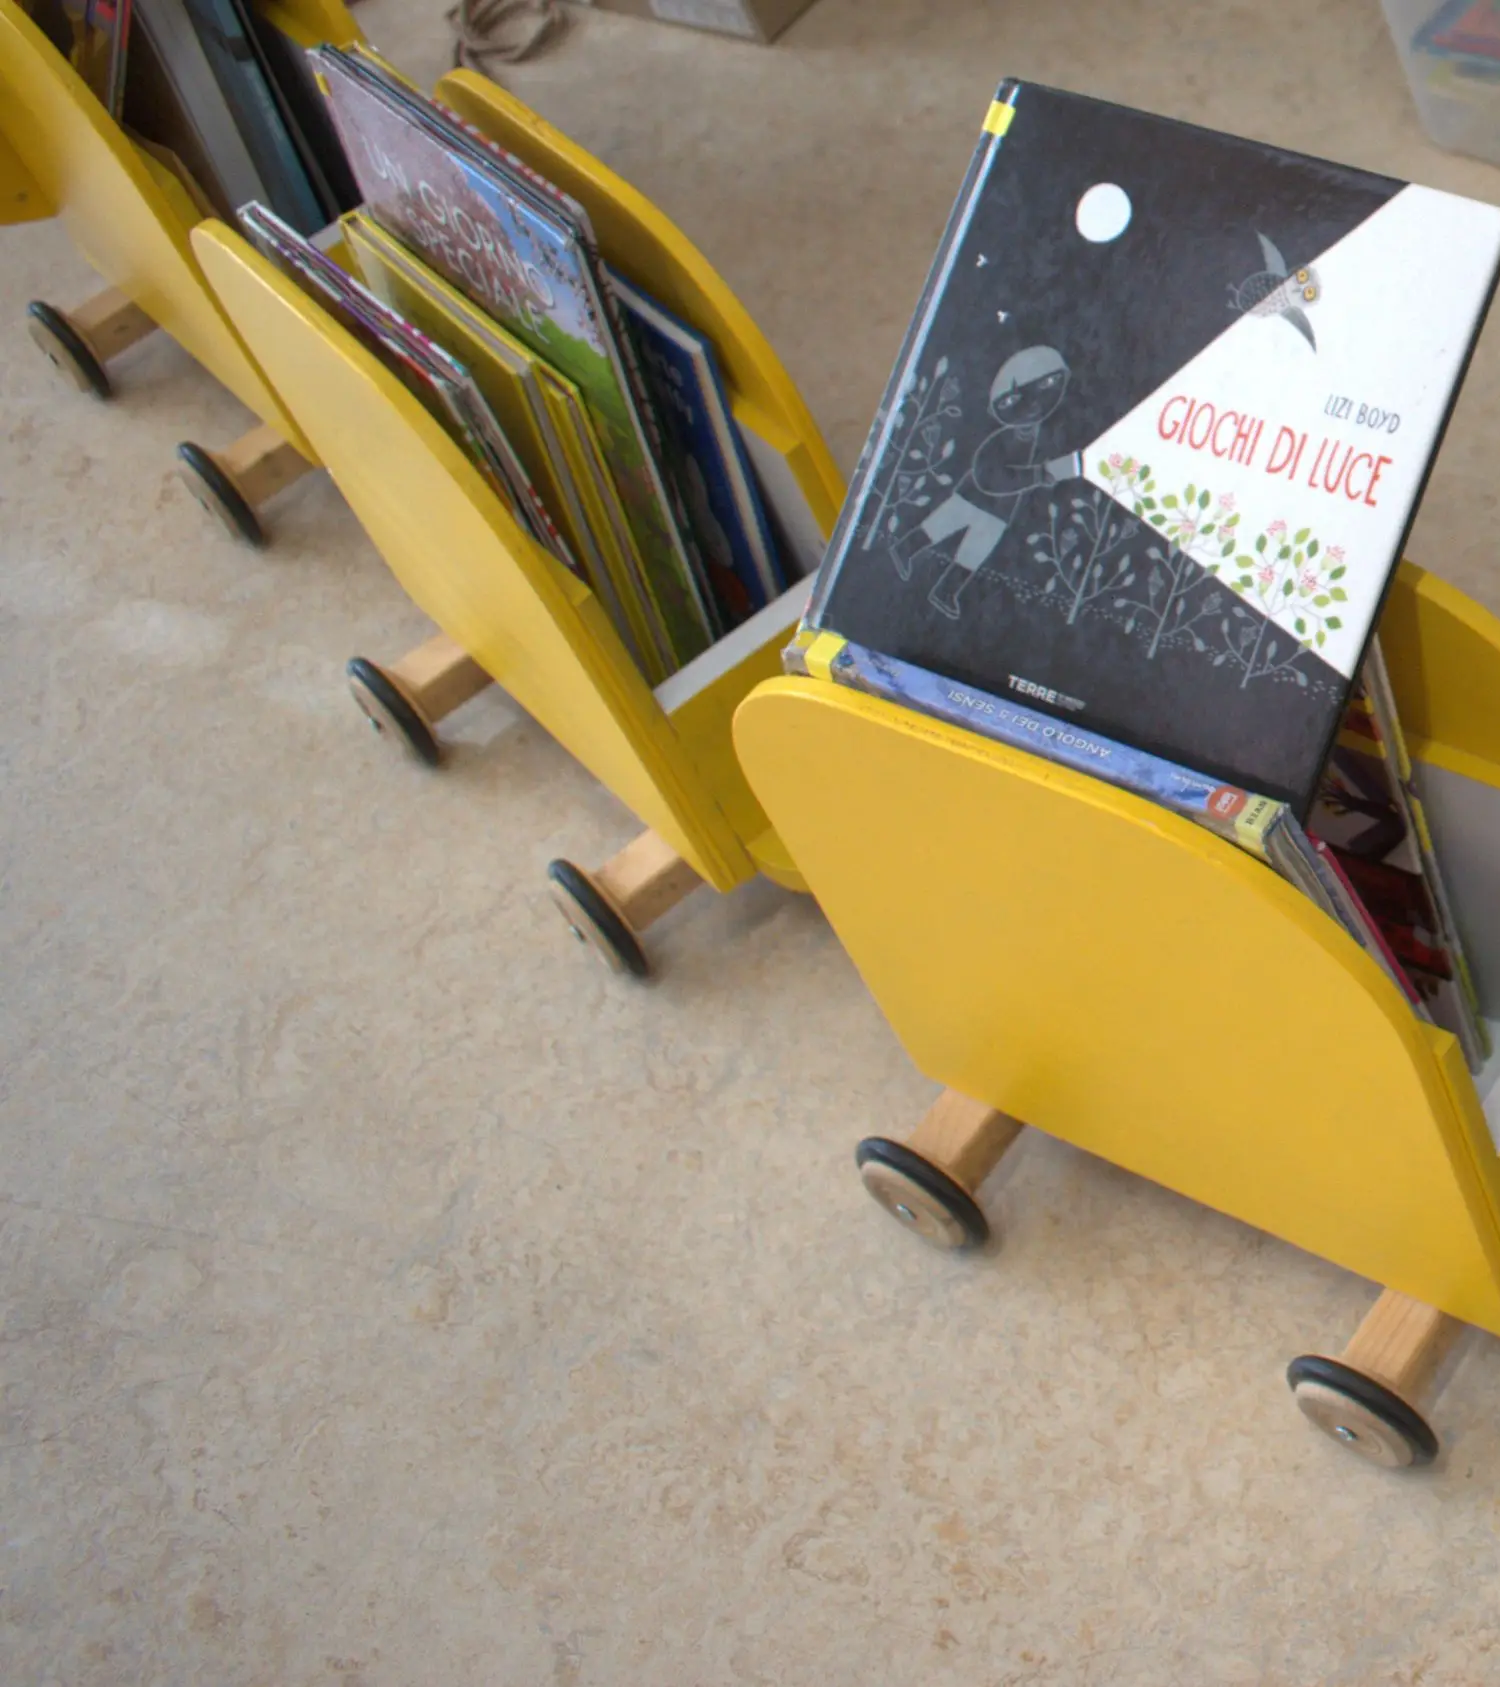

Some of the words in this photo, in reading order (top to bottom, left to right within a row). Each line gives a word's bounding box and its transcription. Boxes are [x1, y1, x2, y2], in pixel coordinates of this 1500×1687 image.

[418, 180, 555, 308] GIORNO
[405, 207, 550, 344] SPECIALE
[1323, 393, 1355, 421] LIZI
[1355, 402, 1401, 435] BOYD
[1158, 394, 1265, 467] GIOCHI
[1265, 425, 1309, 481] DI
[1307, 437, 1394, 508] LUCE
[949, 689, 996, 715] SENSI
[1008, 673, 1057, 704] TERRE
[1012, 714, 1040, 735] DEI
[1042, 725, 1111, 759] ANGOLO
